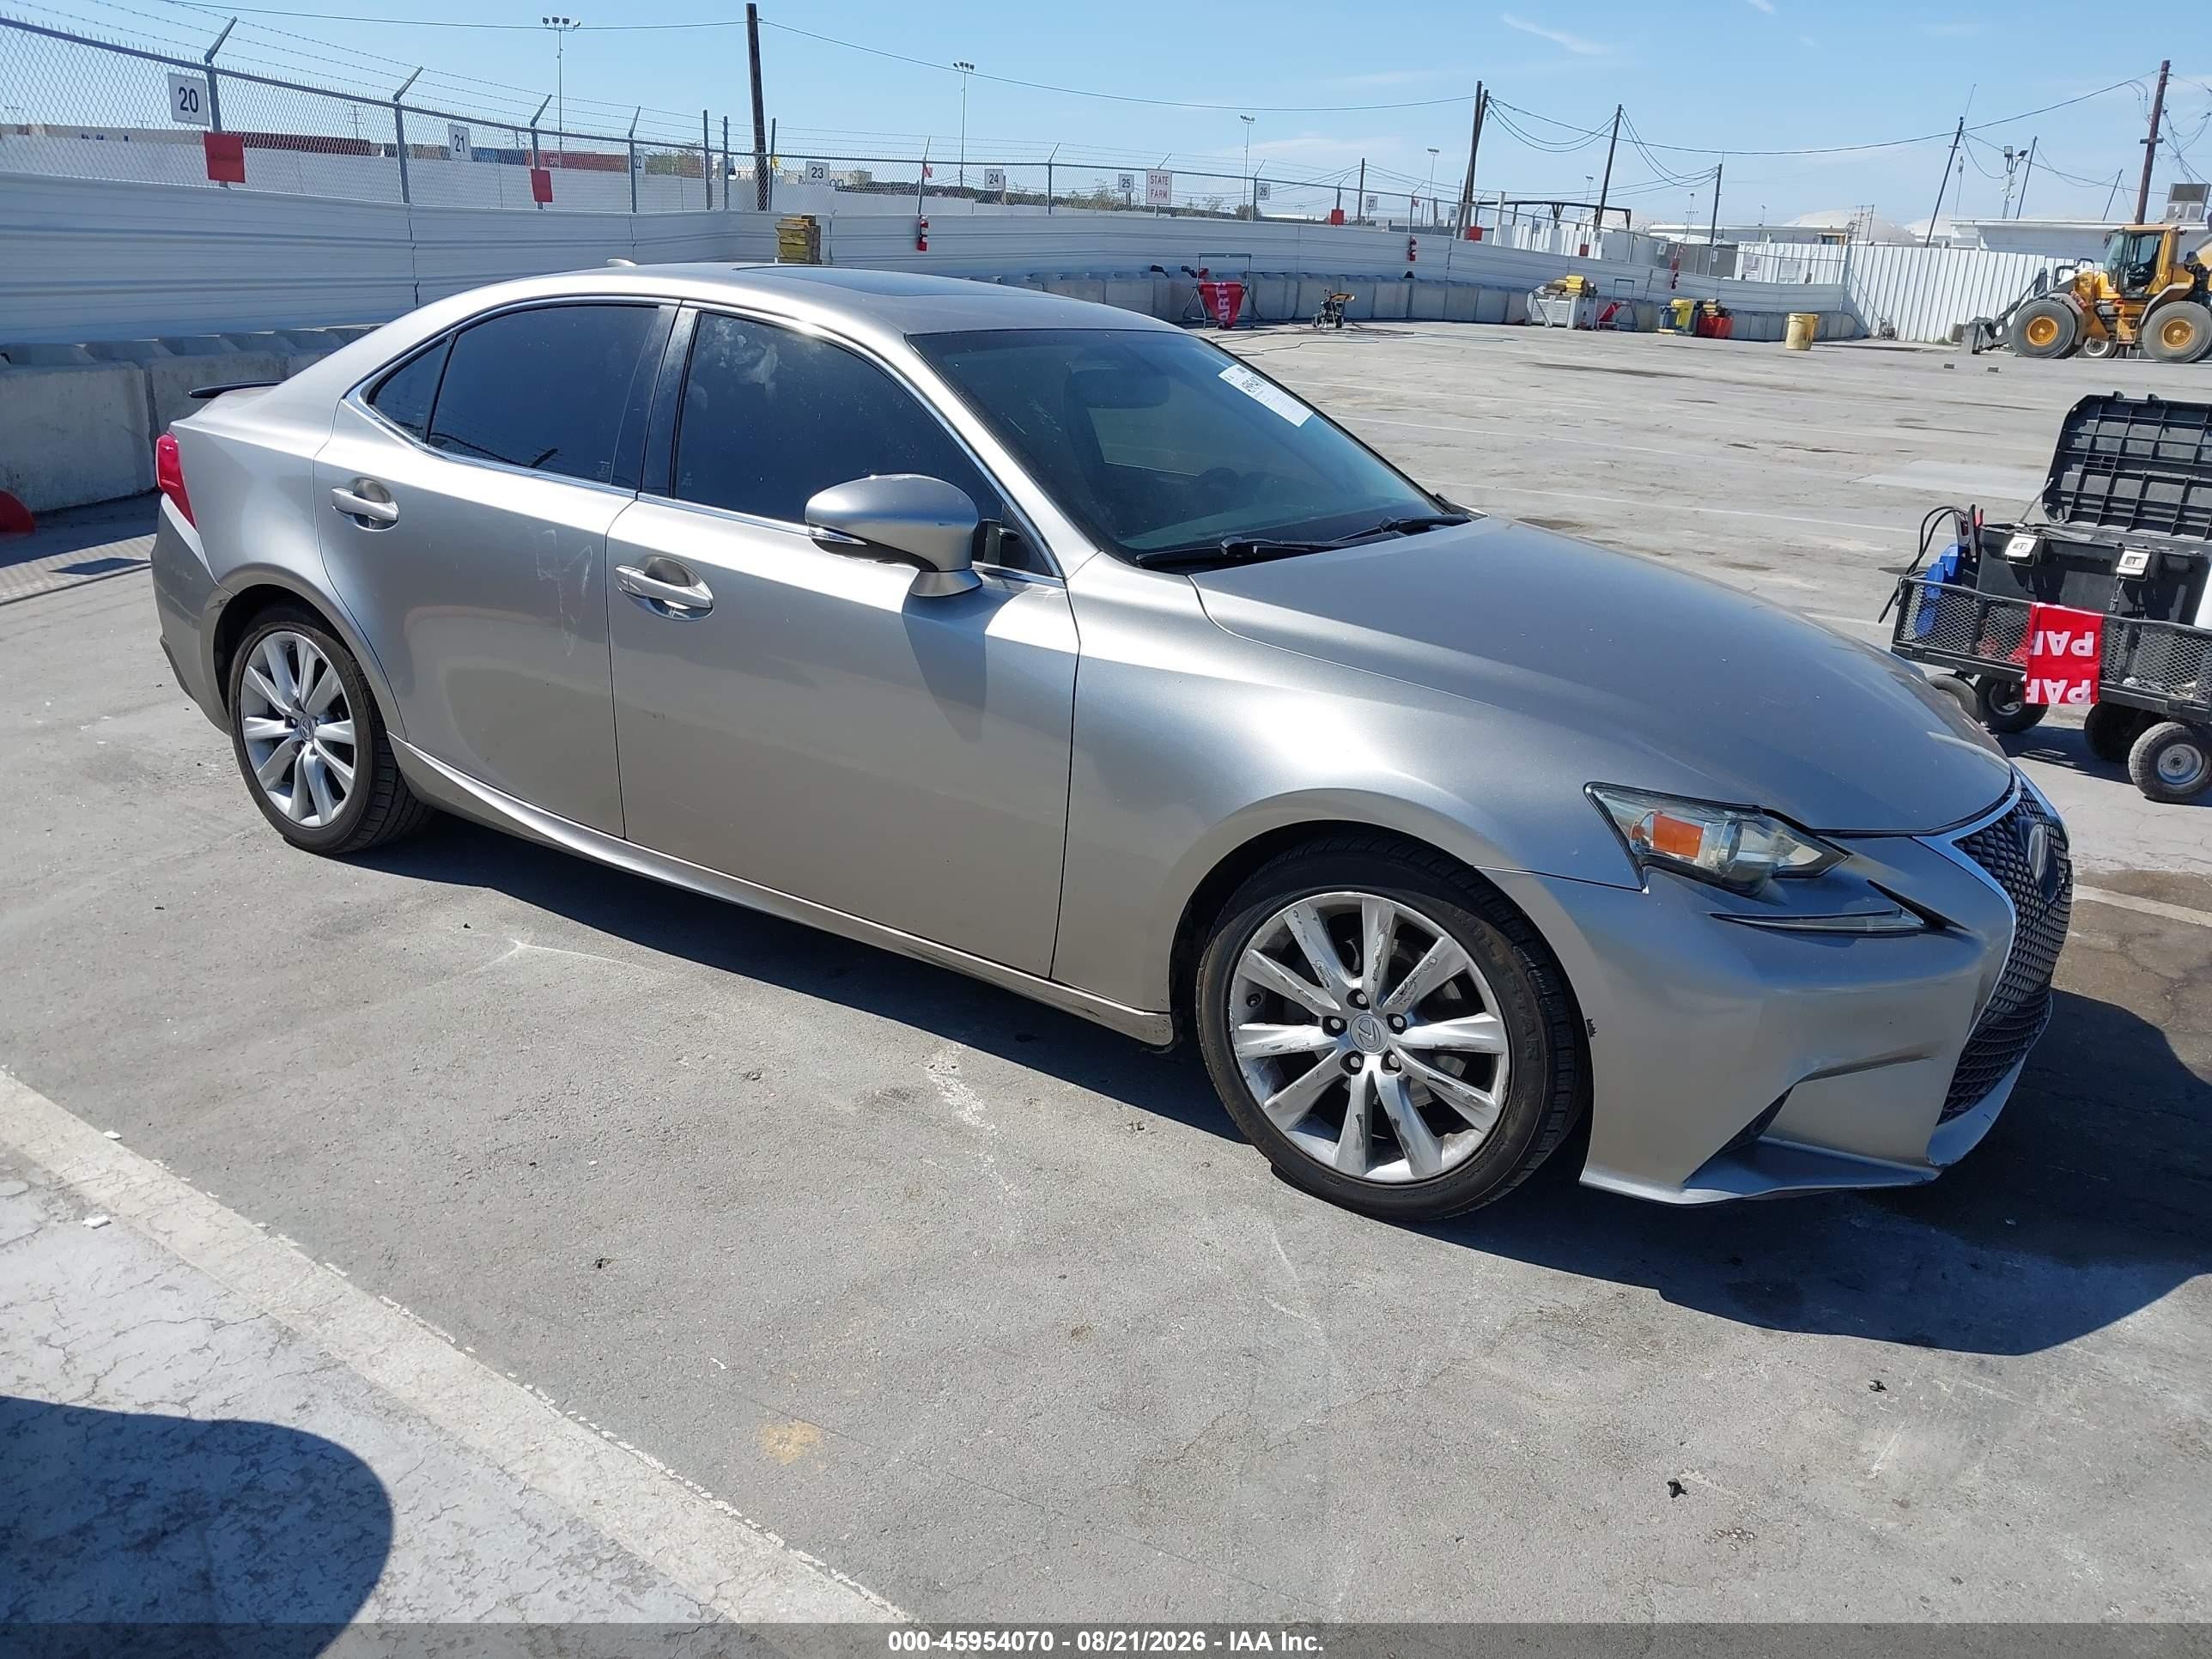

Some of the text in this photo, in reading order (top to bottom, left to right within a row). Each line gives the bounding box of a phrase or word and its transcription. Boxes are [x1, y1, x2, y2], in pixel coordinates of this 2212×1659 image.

[178, 86, 199, 113] 20
[453, 134, 466, 154] 21
[634, 155, 643, 169] 22
[811, 167, 824, 179] 23
[988, 173, 1000, 185] 24
[1121, 178, 1131, 189] 25
[1150, 174, 1169, 186] STATE
[1150, 188, 1168, 200] FARM
[1260, 186, 1267, 197] 26
[1368, 198, 1376, 208] 27
